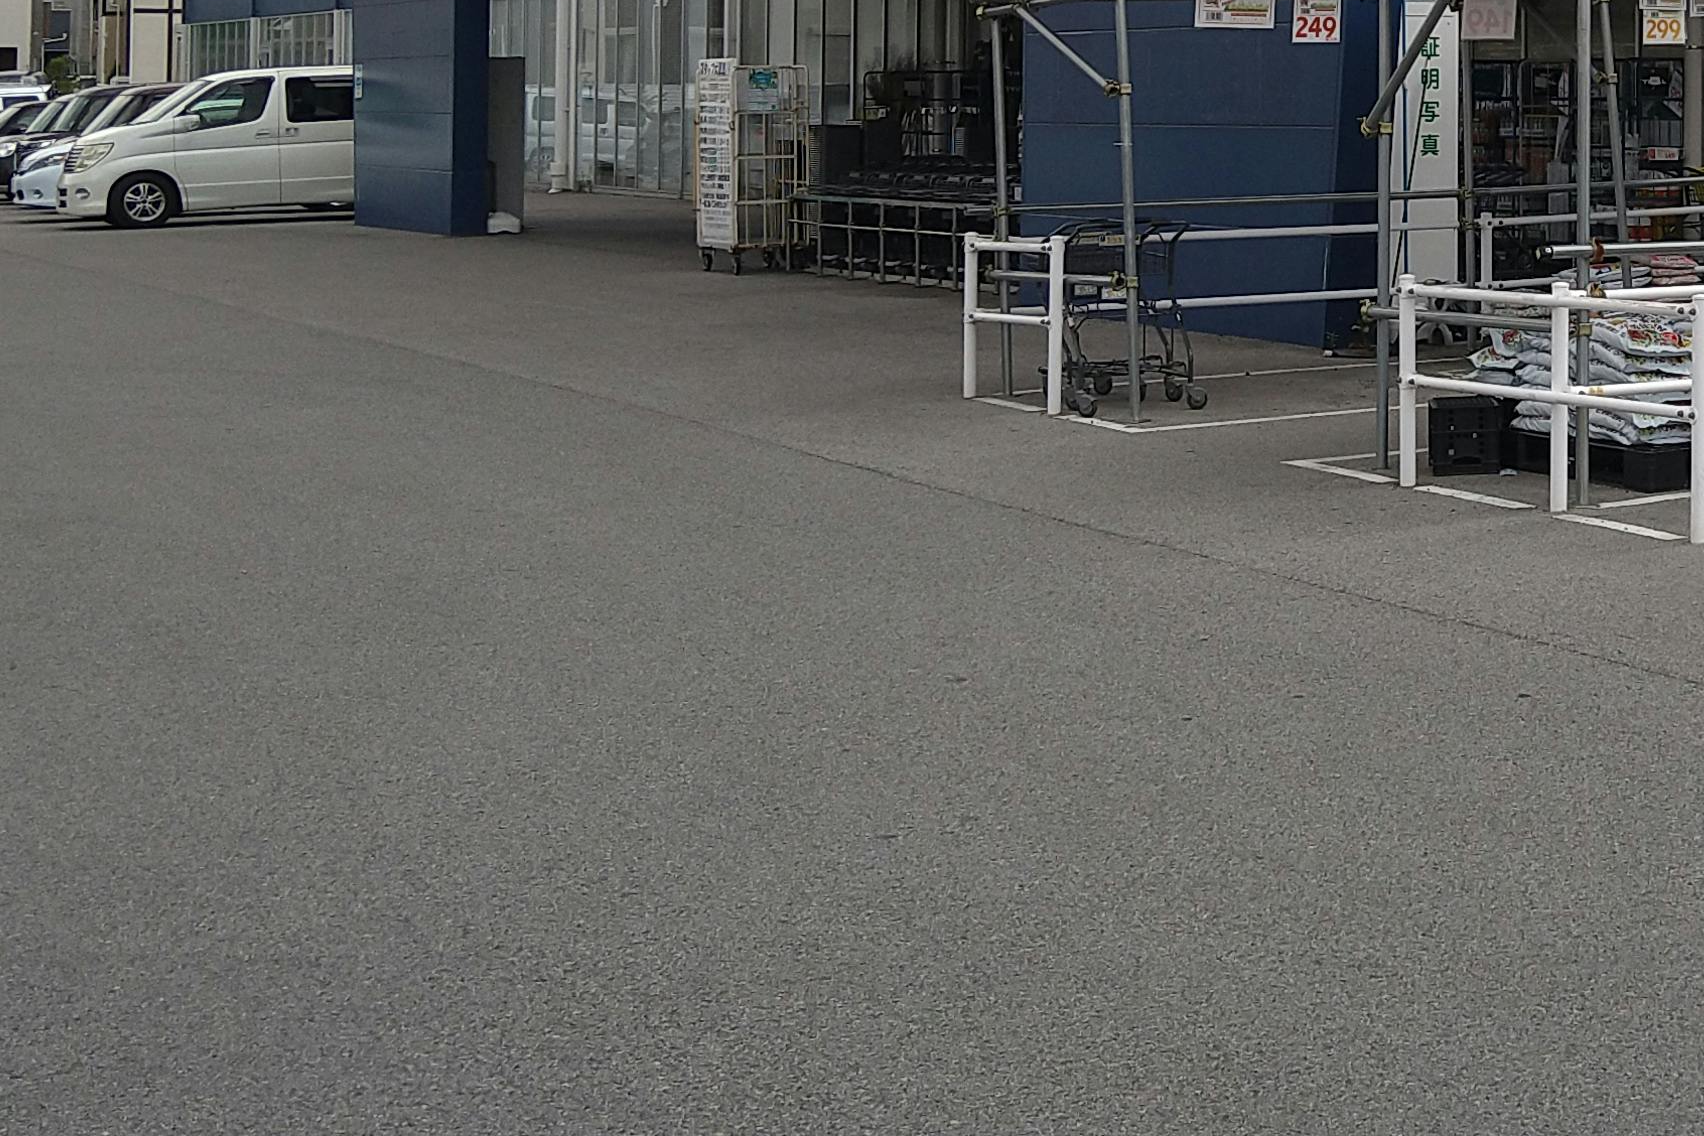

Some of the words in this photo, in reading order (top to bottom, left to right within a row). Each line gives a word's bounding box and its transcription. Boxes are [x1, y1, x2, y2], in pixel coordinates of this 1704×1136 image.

[1295, 16, 1337, 39] 249
[1646, 19, 1681, 40] 299
[1420, 36, 1440, 157] 証明写真
